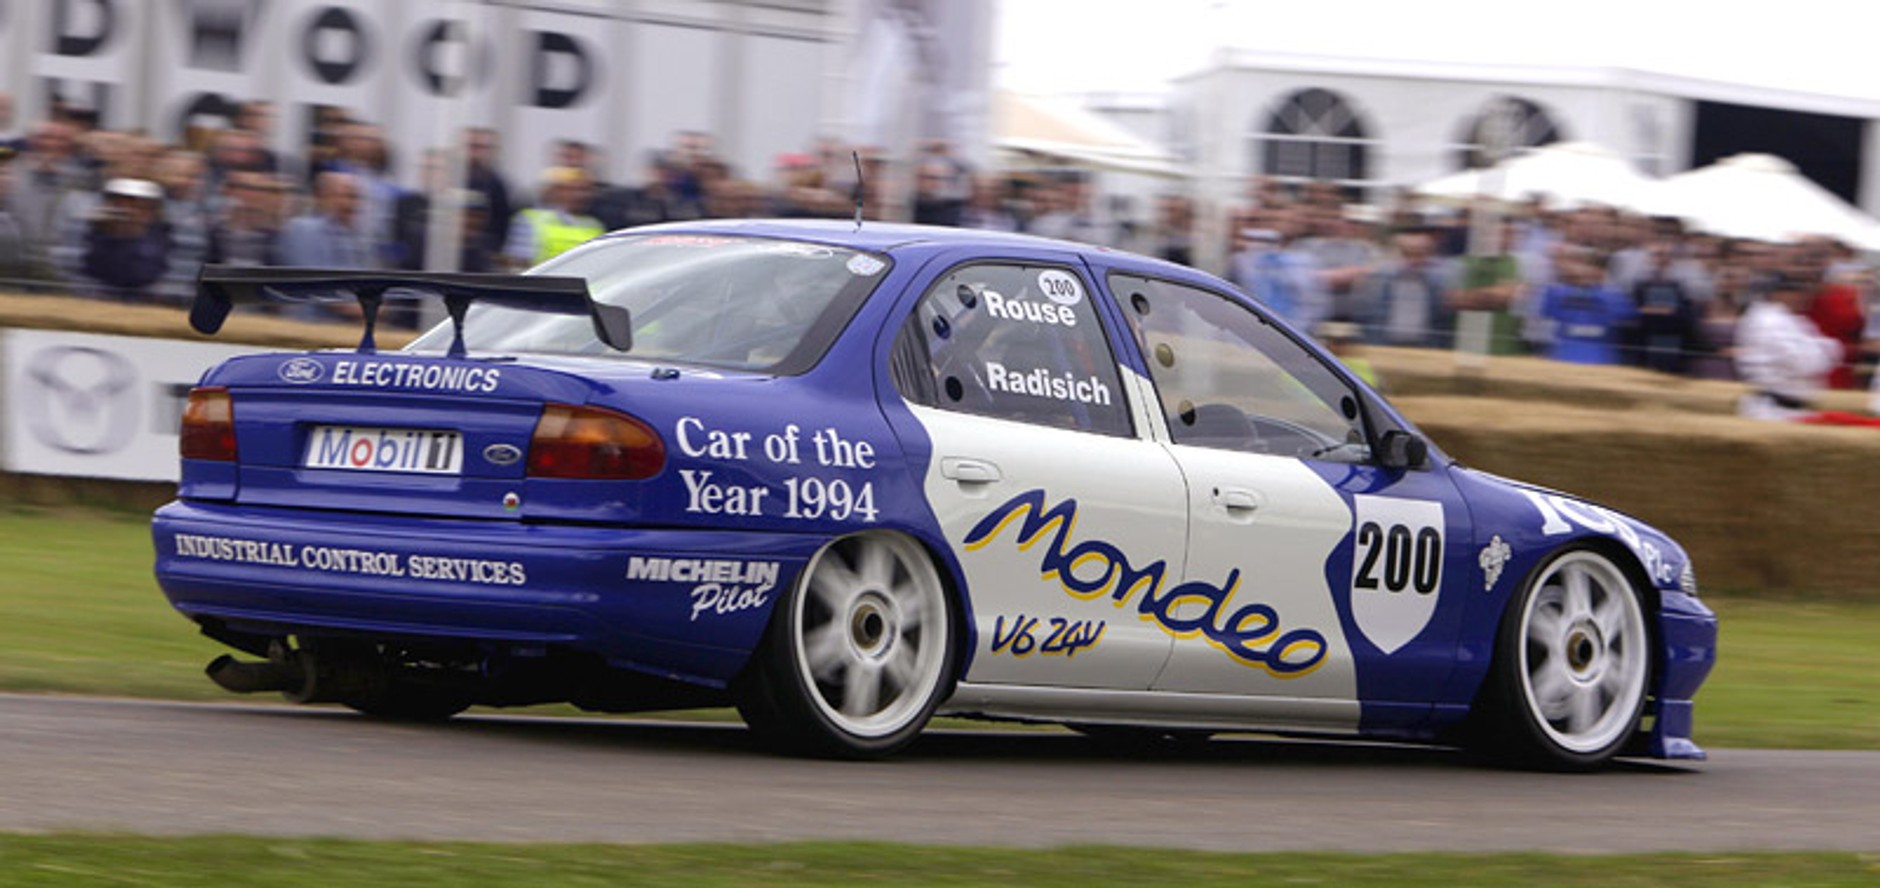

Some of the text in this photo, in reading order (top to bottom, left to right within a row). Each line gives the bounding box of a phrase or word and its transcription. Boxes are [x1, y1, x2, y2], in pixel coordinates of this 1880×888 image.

[982, 289, 1076, 327] Rouse
[1043, 277, 1076, 298] 200
[332, 361, 501, 392] ELECTRONICS
[986, 361, 1111, 406] Radisich
[317, 428, 455, 470] Mobil 1
[676, 416, 877, 469] Car of the
[679, 469, 879, 522] Year 1994
[175, 534, 526, 585] INDUSTRIAL CONTROL SERVICES
[626, 556, 780, 584] MICHELIN
[1354, 521, 1442, 595] 200
[690, 582, 774, 622] Pilot
[963, 488, 1328, 679] Mondeo
[991, 614, 1039, 658] V6
